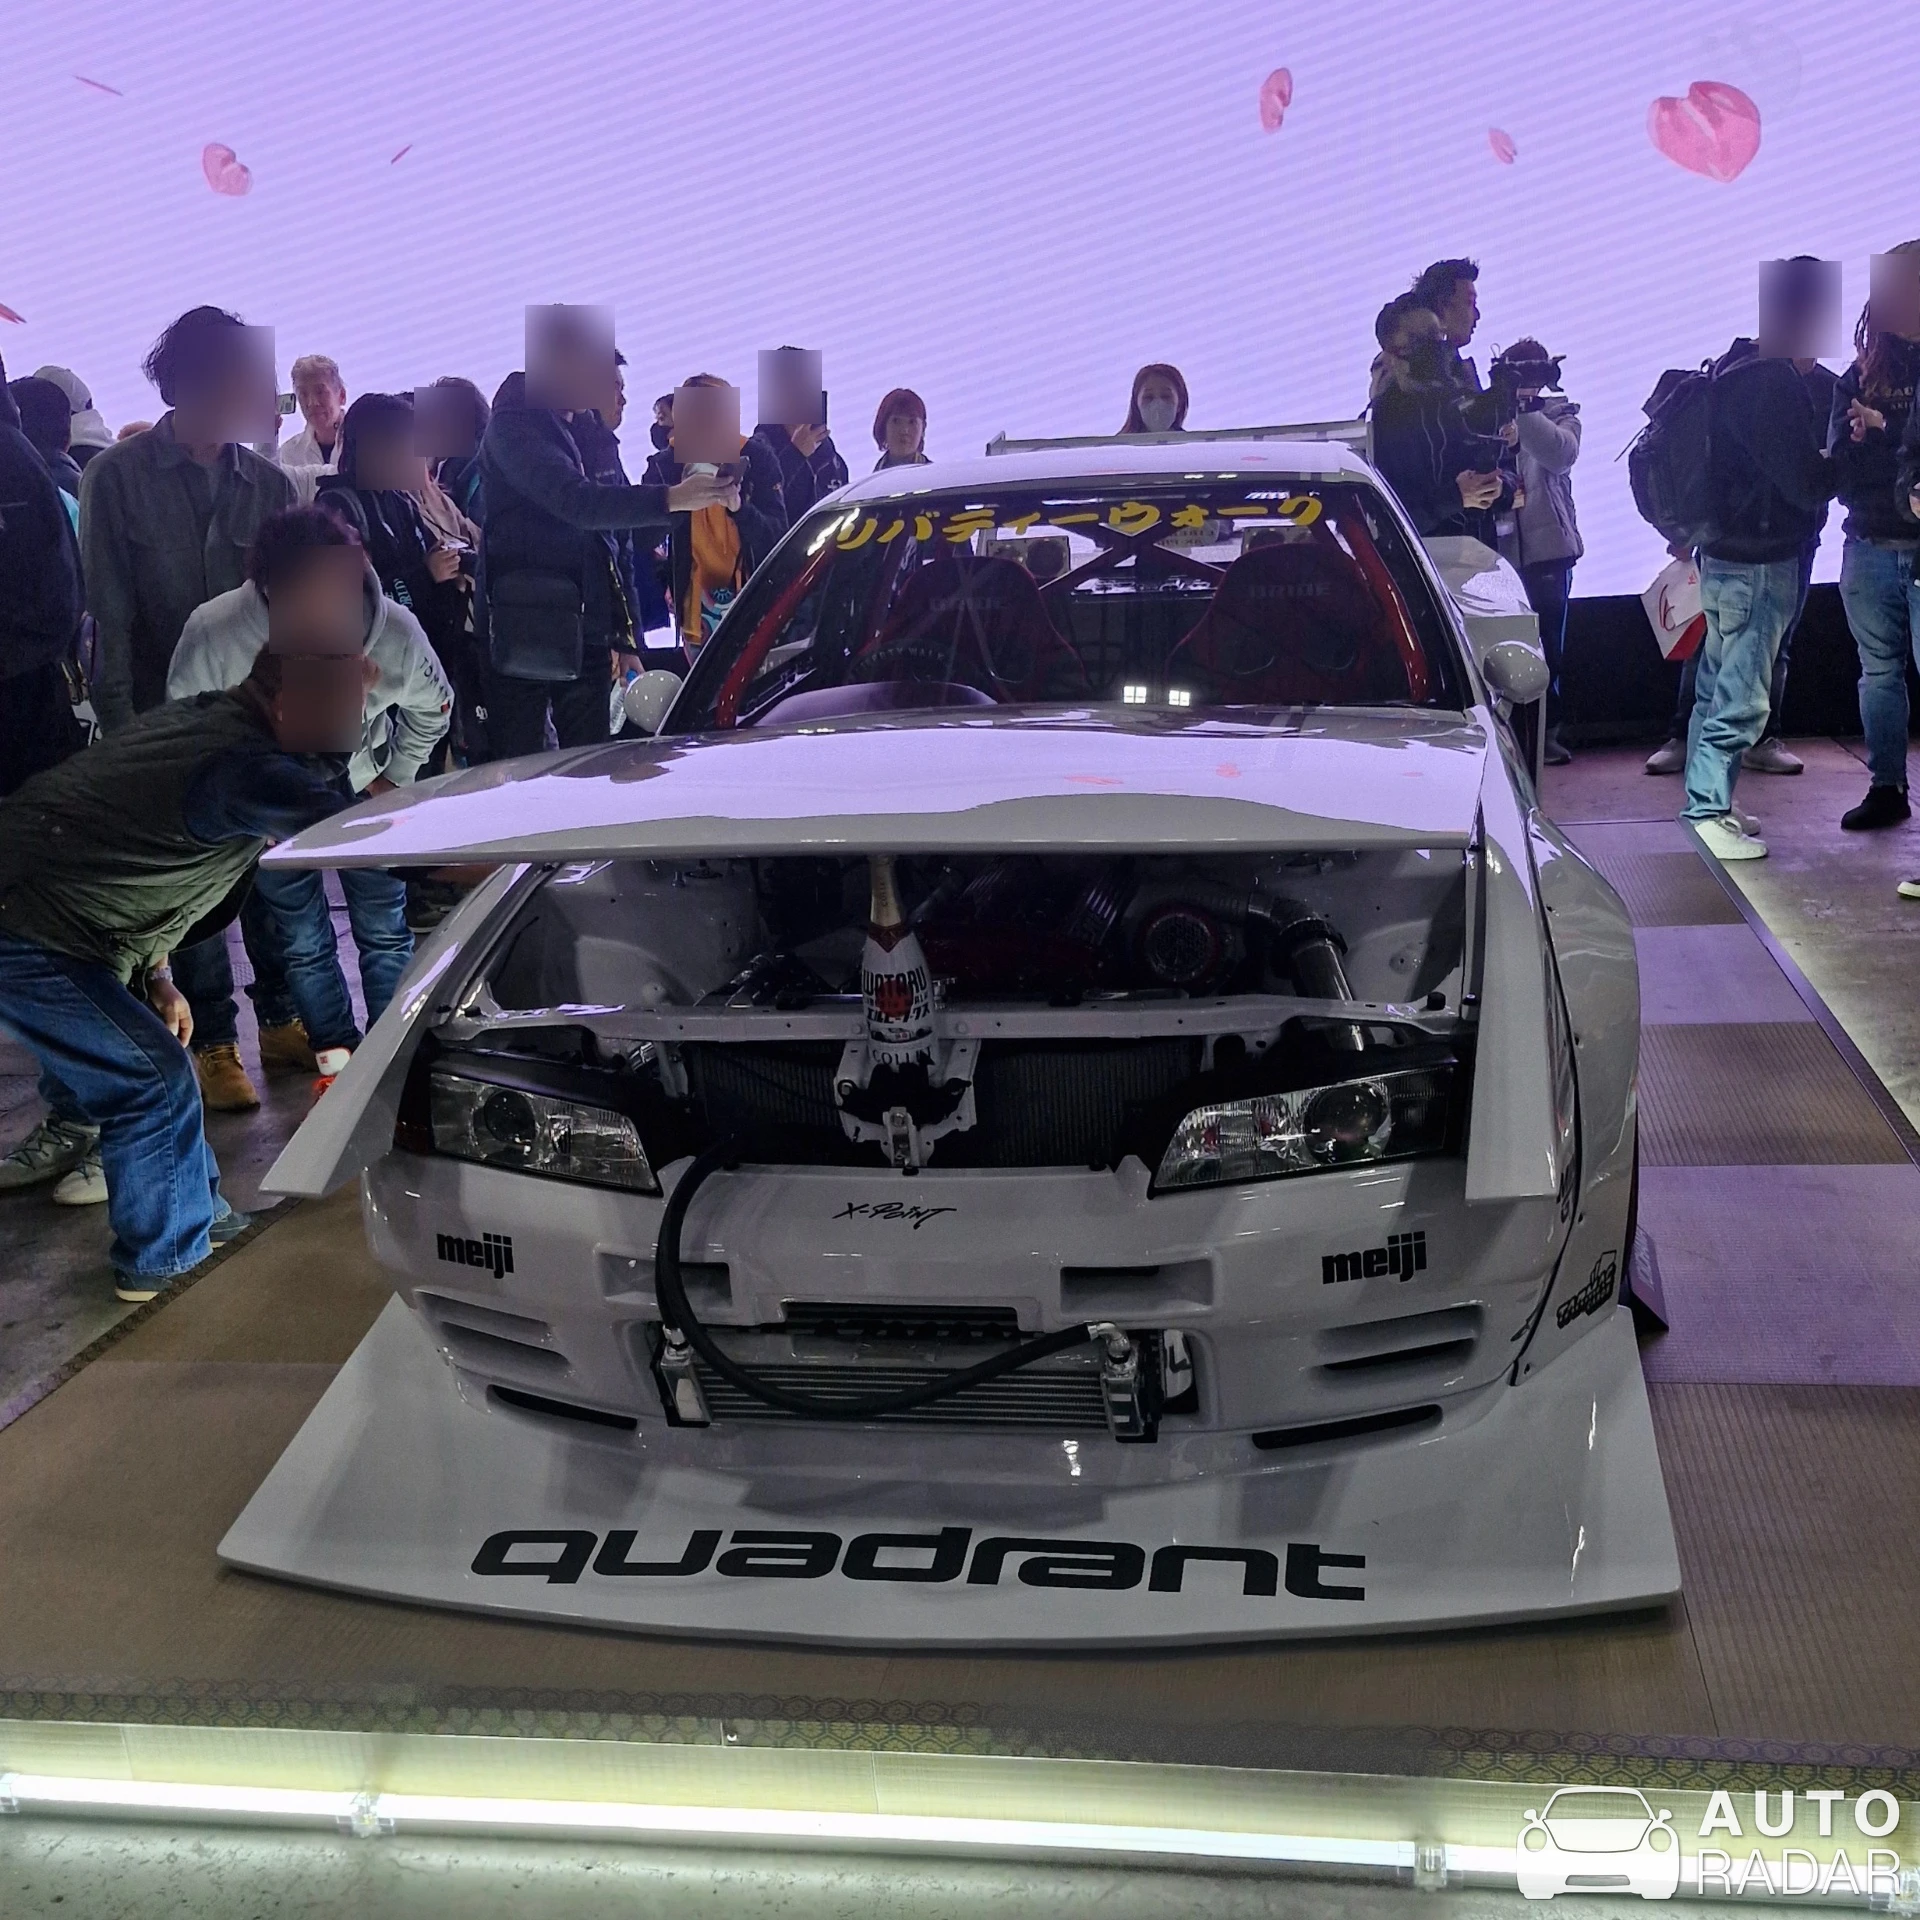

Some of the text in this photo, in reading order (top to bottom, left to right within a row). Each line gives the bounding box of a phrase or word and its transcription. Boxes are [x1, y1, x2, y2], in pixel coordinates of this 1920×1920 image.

[836, 495, 1323, 549] リバティーウォーク
[436, 1232, 514, 1279] meiji
[1322, 1231, 1427, 1283] meiji
[471, 1527, 1365, 1600] quadrant
